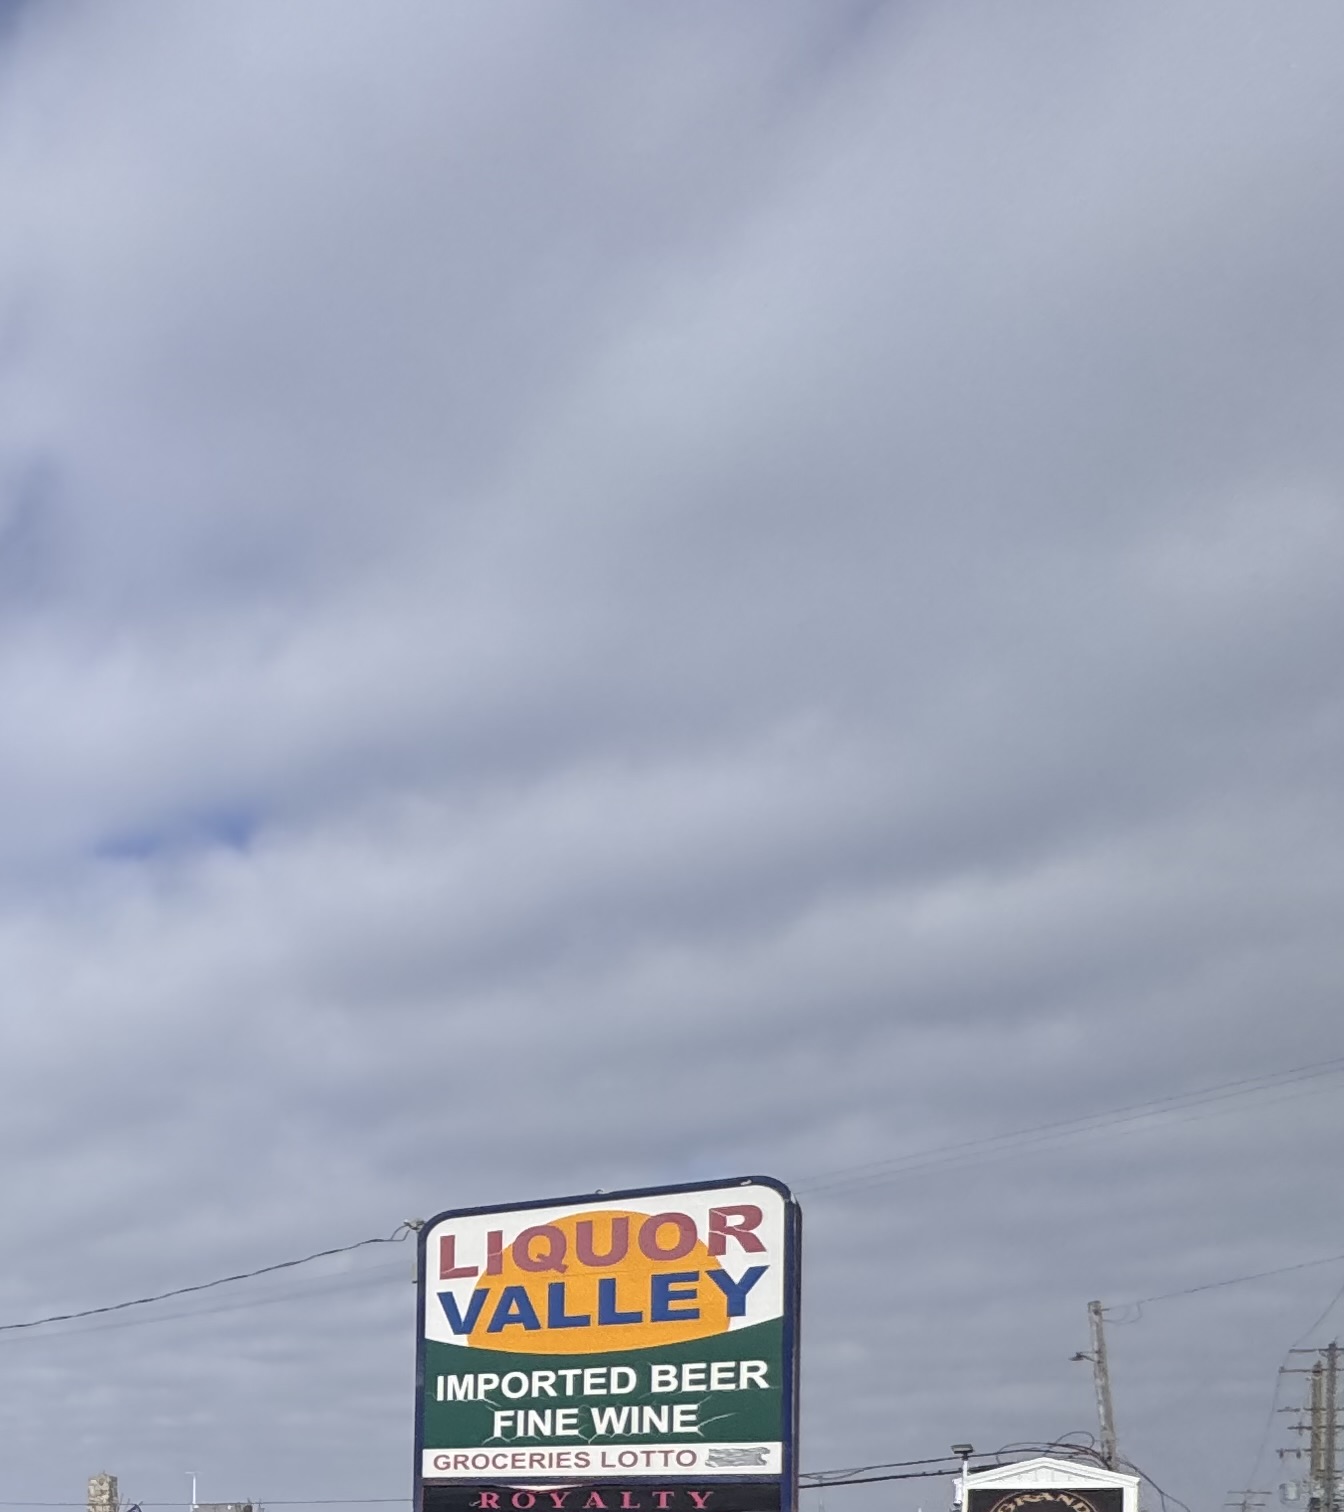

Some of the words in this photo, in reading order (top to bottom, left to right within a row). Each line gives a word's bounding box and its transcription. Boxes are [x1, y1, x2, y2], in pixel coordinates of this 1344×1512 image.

[438, 1204, 767, 1281] LIQUOR
[436, 1264, 770, 1336] VALLEY
[436, 1366, 638, 1402] IMPORTED
[650, 1360, 770, 1394] BEER
[493, 1408, 580, 1438] FINE
[590, 1404, 700, 1436] WINE
[433, 1450, 591, 1471] GROCERIES
[601, 1449, 698, 1468] LOTTO
[478, 1490, 716, 1511] ROYALTY
